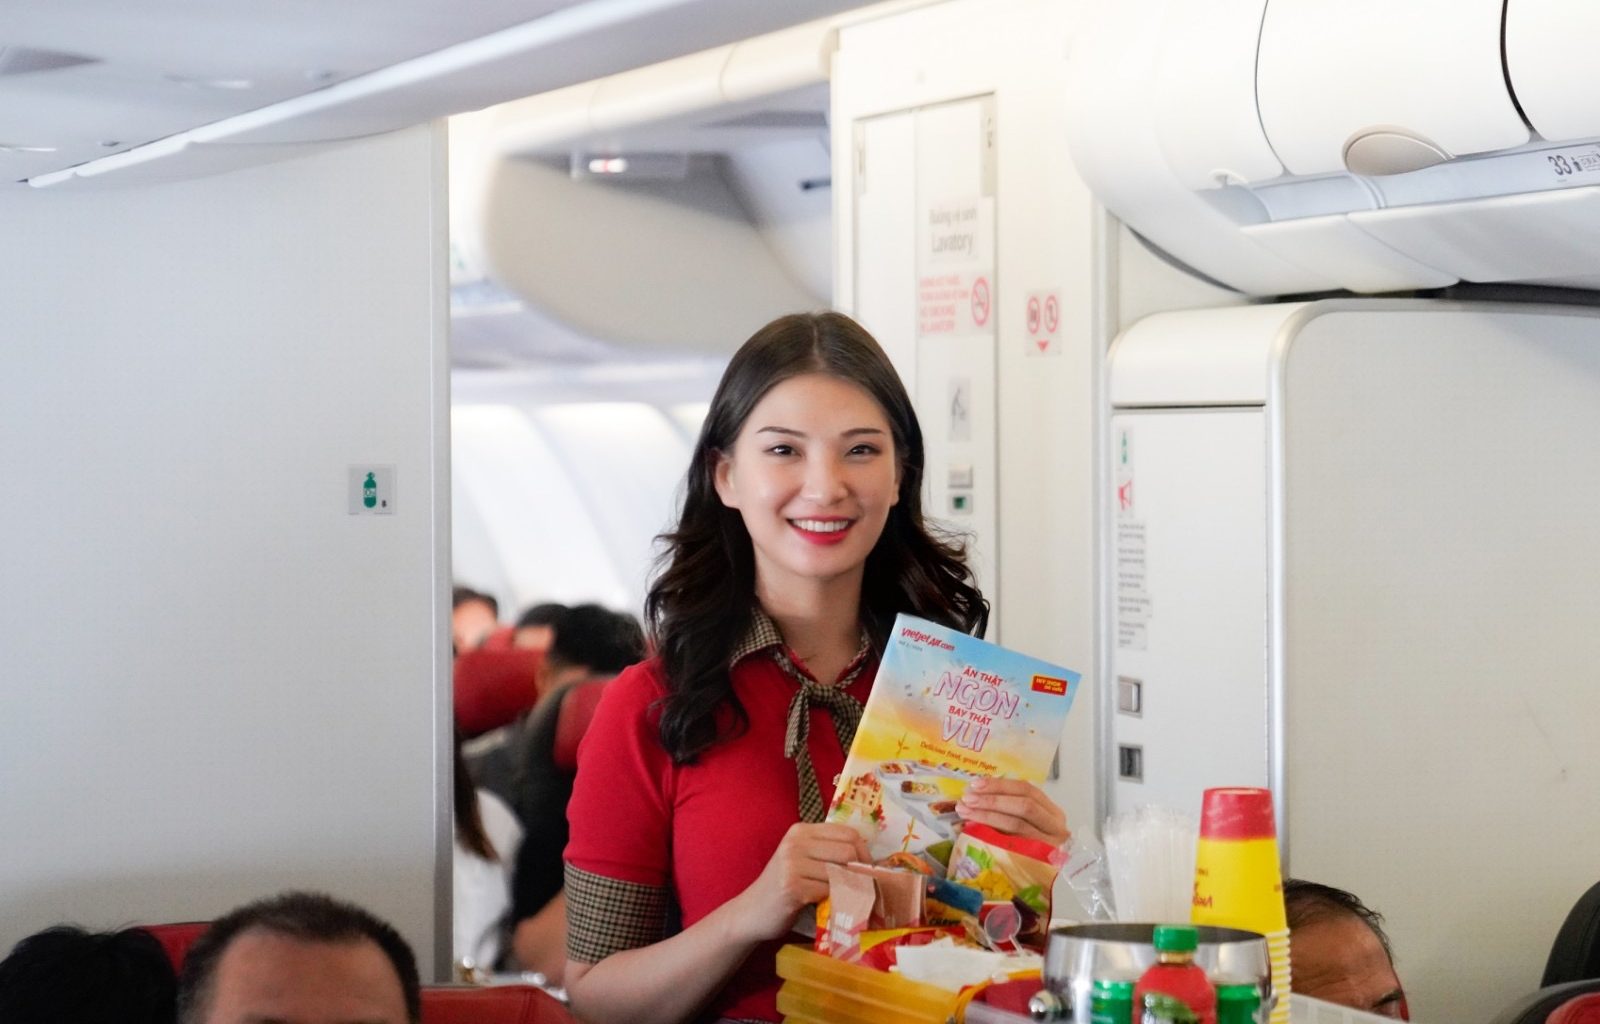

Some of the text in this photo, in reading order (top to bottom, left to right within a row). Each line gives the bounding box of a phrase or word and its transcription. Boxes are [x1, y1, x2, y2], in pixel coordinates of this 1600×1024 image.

[1547, 155, 1573, 175] 33
[931, 233, 974, 255] Lavatory
[933, 671, 1020, 720] NGON
[948, 705, 968, 718] BAY
[942, 714, 990, 753] VUI
